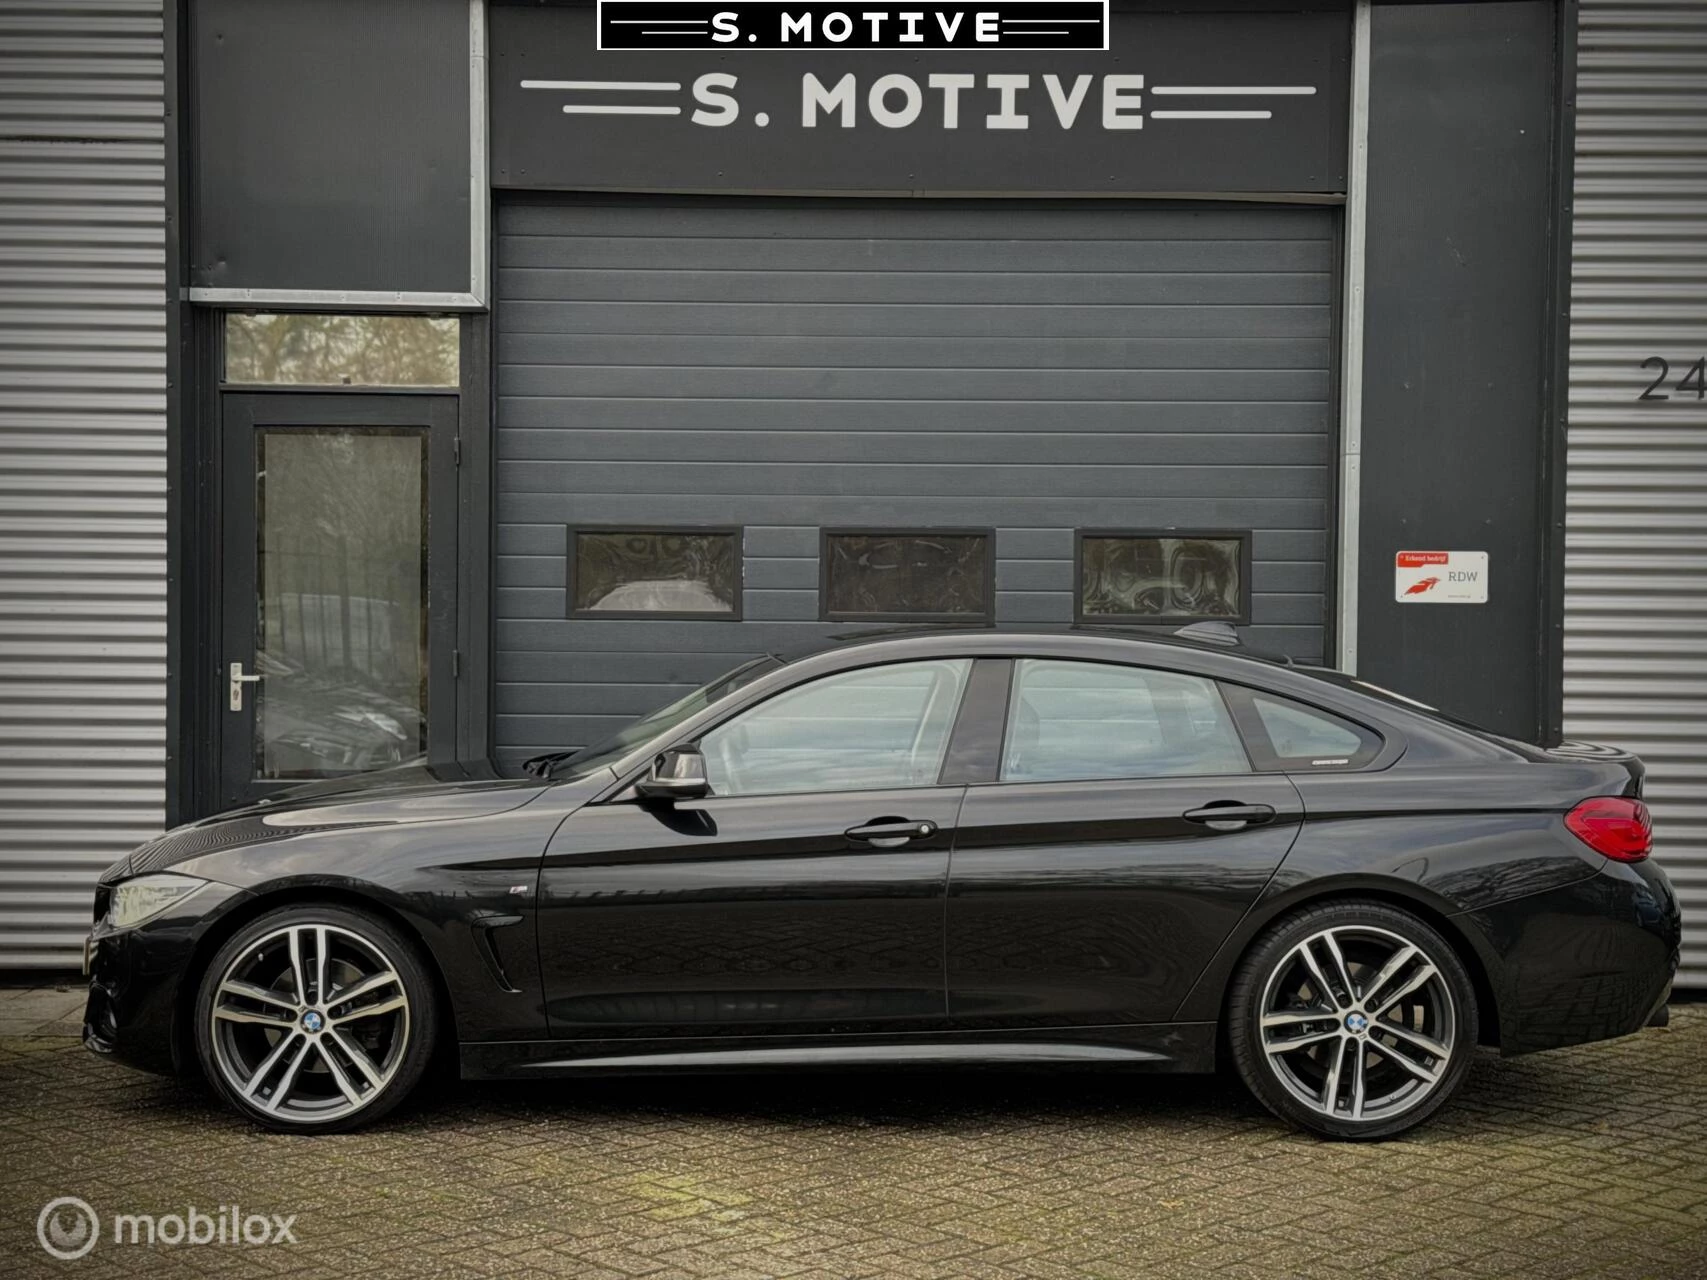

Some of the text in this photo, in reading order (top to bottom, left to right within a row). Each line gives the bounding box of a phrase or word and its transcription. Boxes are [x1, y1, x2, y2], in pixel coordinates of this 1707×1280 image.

[690, 72, 1145, 130] S. MOTIVE
[1638, 355, 1707, 400] 24
[1448, 571, 1478, 582] RDW
